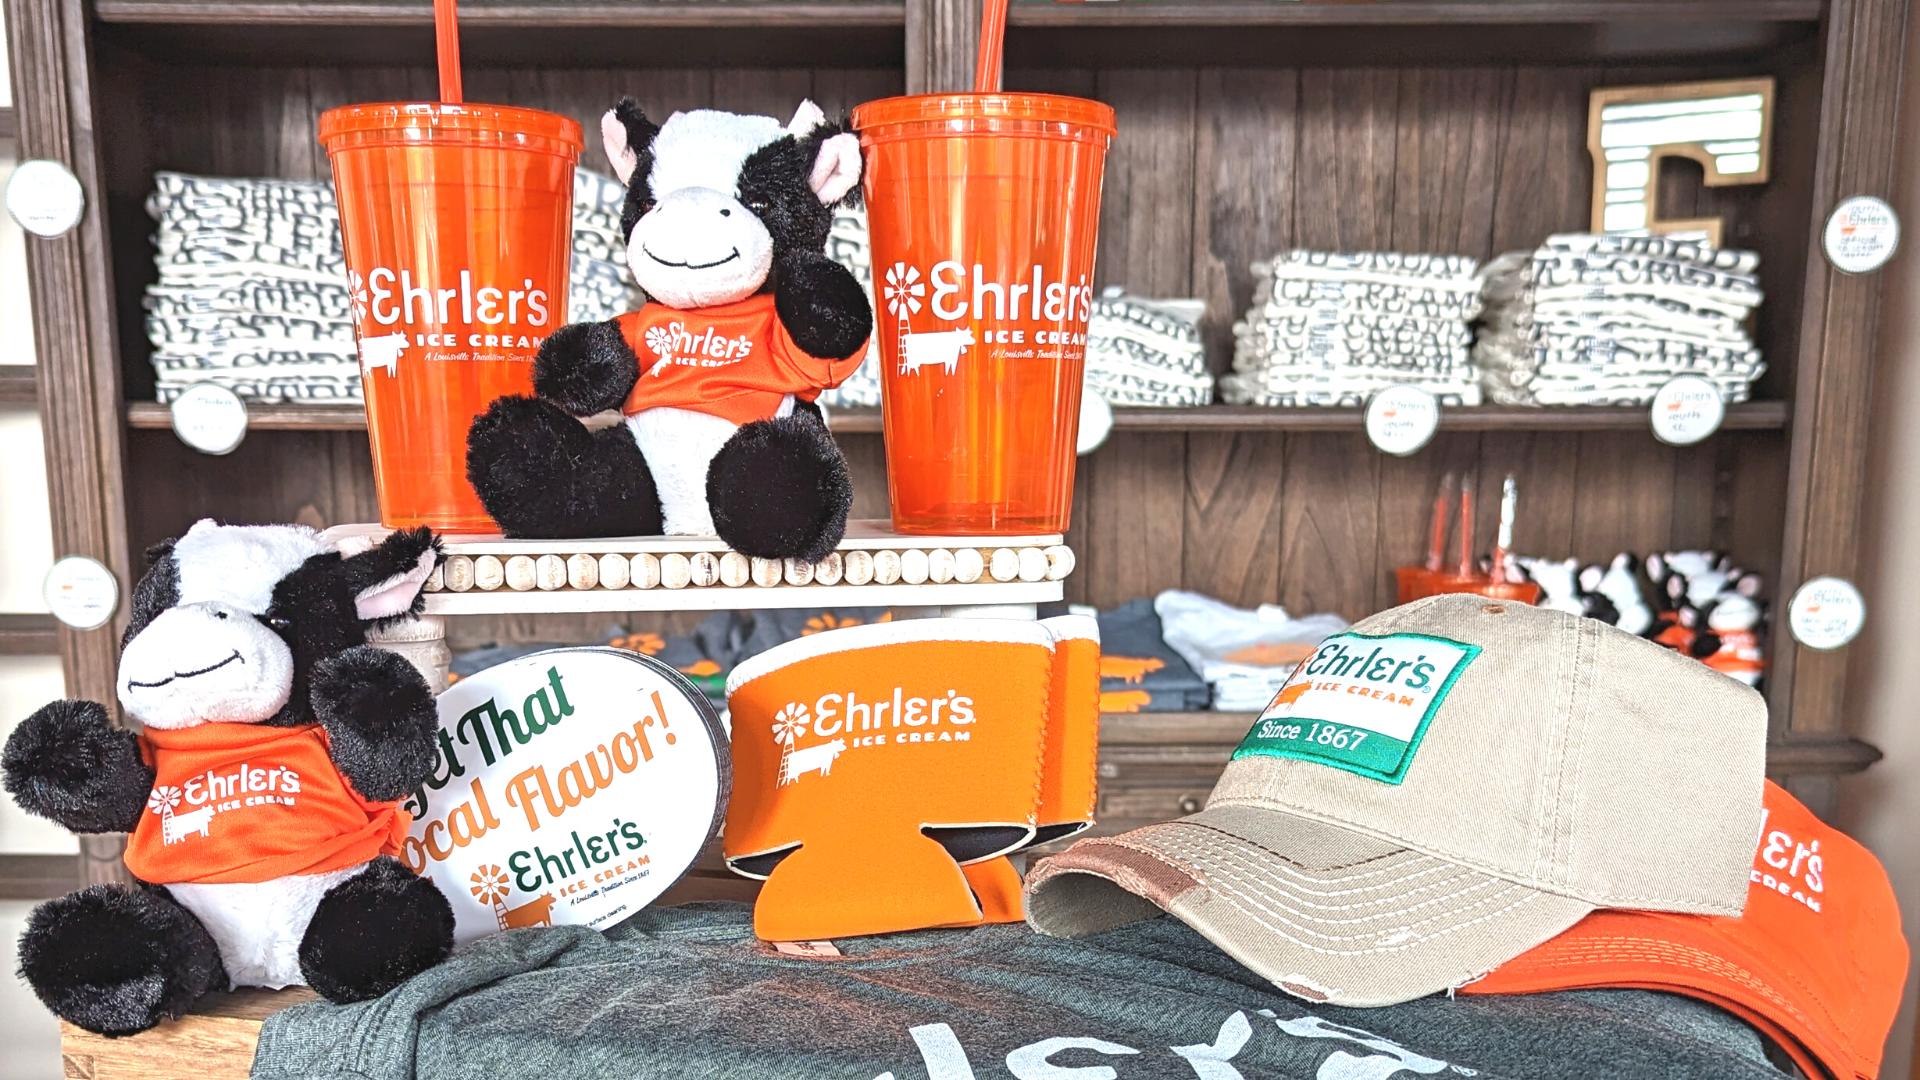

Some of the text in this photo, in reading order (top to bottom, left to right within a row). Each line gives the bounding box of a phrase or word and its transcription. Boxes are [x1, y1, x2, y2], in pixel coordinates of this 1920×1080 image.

[369, 267, 548, 327] Ehrler's
[930, 260, 1091, 323] Ehrler's
[416, 334, 545, 348] ICE CREAM
[984, 330, 1087, 346] ICE CREAM
[1306, 643, 1436, 690] Ehrler's
[1316, 682, 1415, 707] ICE CREAM
[456, 665, 575, 767] That
[1257, 721, 1369, 751] Since 1867
[853, 731, 971, 748] ICE CREAM
[184, 763, 301, 805] Ehrler's
[400, 690, 677, 875] ocal Flavor!
[217, 795, 296, 813] ICE CREAM
[559, 854, 651, 897] ICE CREAM
